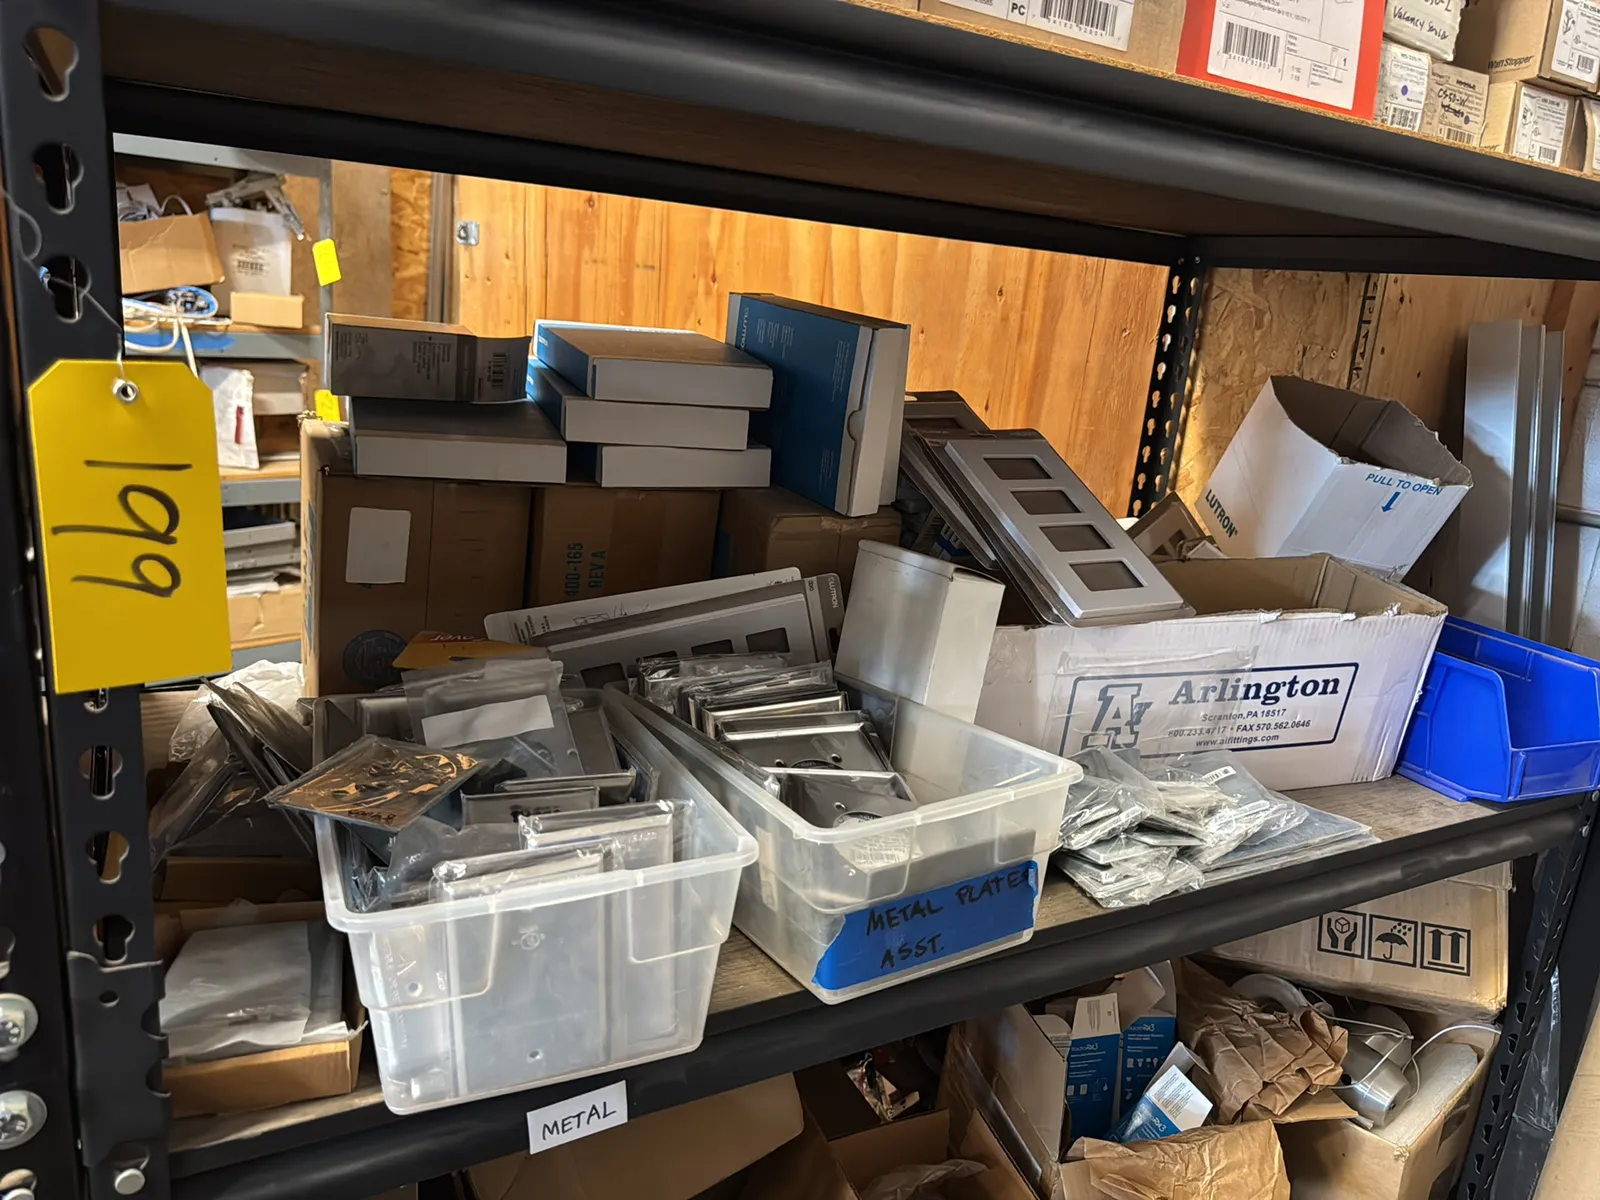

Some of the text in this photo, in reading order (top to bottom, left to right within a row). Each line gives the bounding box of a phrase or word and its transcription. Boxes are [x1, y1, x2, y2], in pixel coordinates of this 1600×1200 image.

[1010, 2, 1026, 16] PC
[740, 311, 749, 350] LUTRO
[1365, 473, 1443, 496] PULL TO OPEN
[1205, 489, 1237, 538] LUTRON
[588, 550, 606, 588] REV A
[828, 579, 840, 609] LUTRON
[1168, 674, 1340, 706] Arlington
[1236, 723, 1254, 733] FAX
[1255, 720, 1311, 731] 570.562.0646
[1260, 708, 1287, 719] 18517
[1196, 733, 1279, 747] www.aifittings.com
[866, 899, 944, 936] METAL
[880, 933, 945, 969] ASST.
[542, 1101, 617, 1141] METAL
